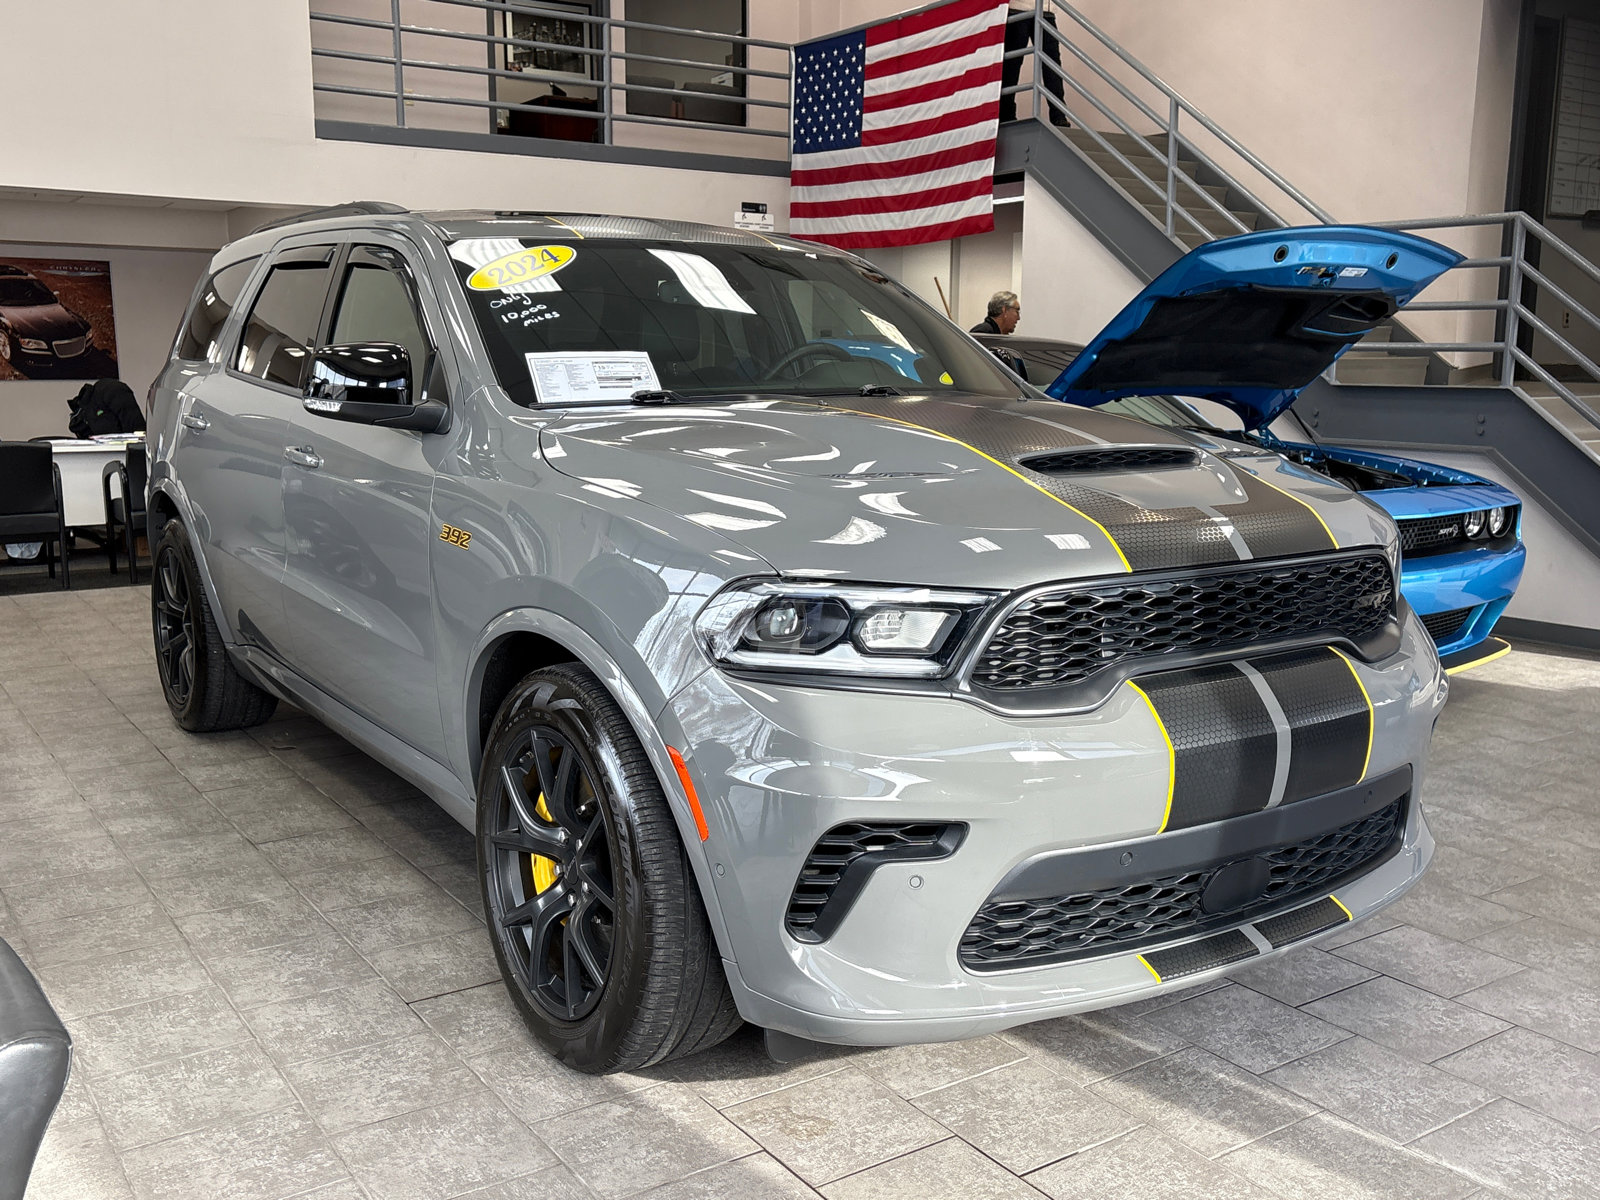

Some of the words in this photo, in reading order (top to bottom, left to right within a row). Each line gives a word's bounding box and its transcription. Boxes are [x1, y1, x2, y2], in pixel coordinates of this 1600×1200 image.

[487, 248, 562, 285] 2024
[501, 304, 547, 323] 10,000
[439, 523, 472, 551] 392
